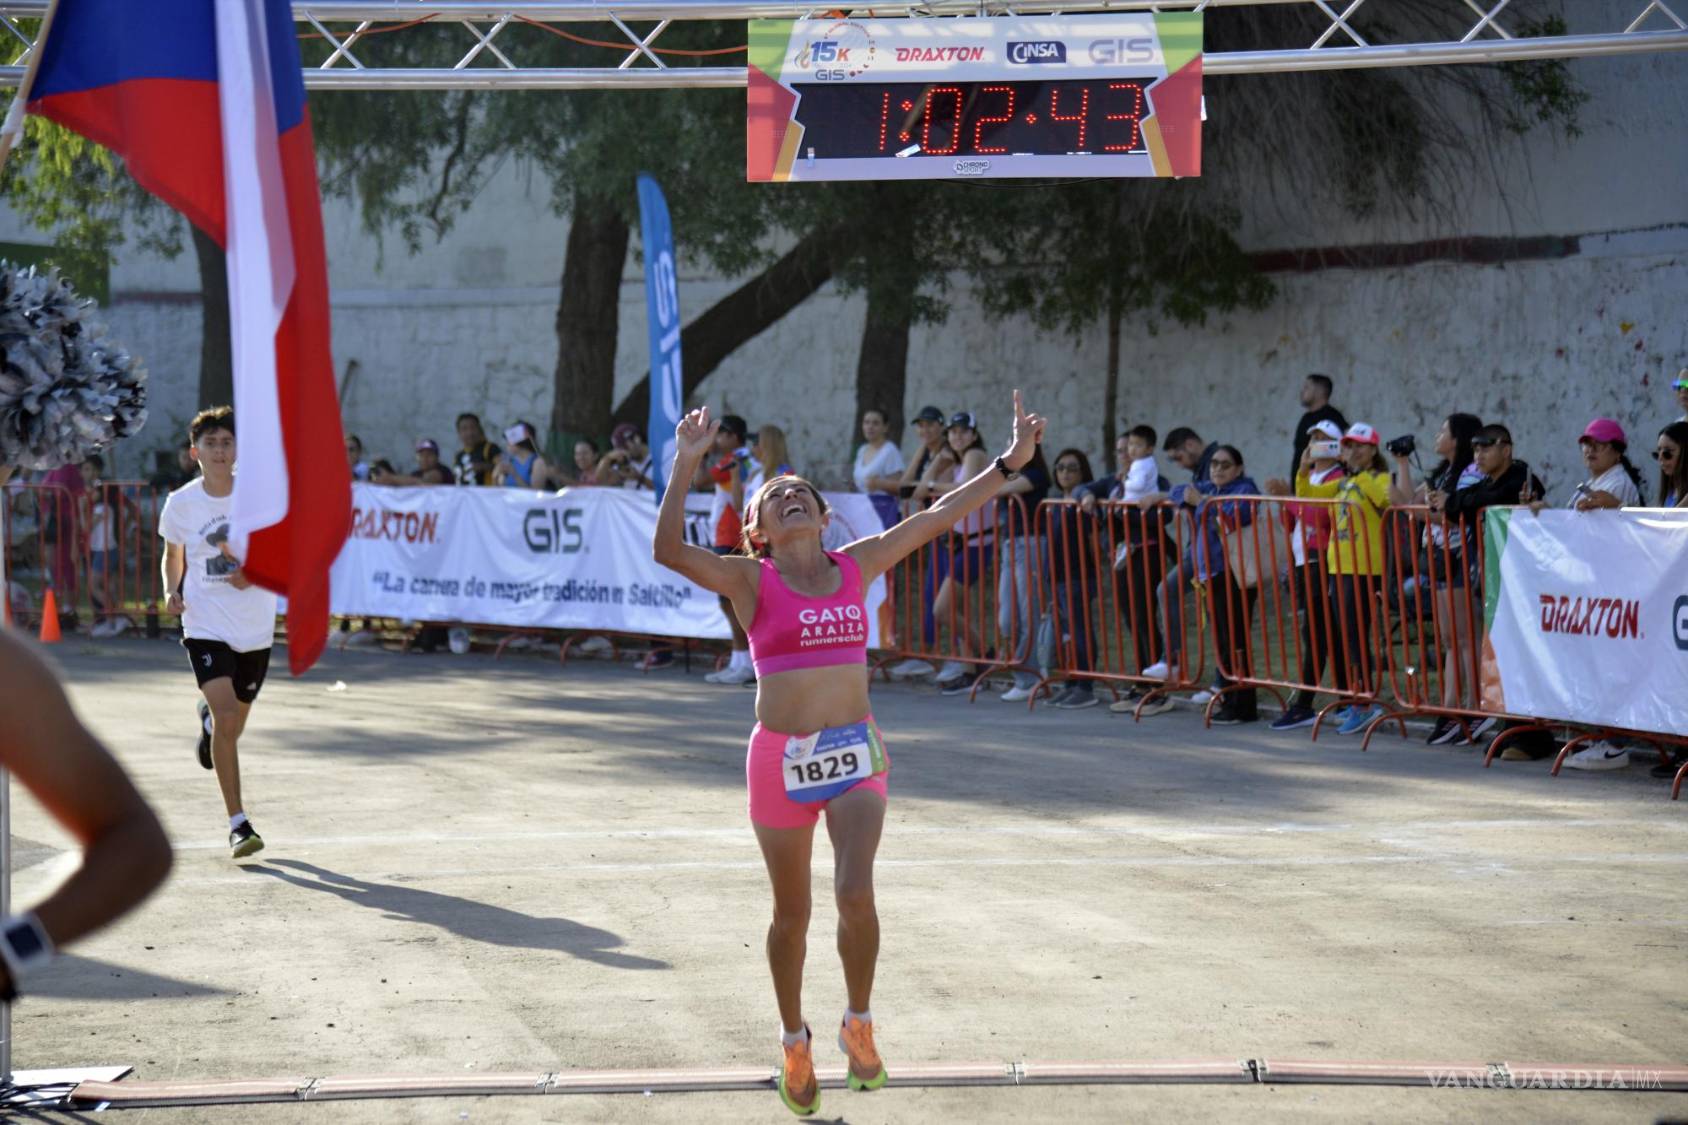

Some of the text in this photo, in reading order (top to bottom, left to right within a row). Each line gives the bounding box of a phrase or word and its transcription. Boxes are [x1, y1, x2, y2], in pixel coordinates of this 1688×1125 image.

[811, 41, 851, 62] 15K
[895, 46, 984, 62] DRAXTON
[1088, 38, 1154, 64] GIS
[815, 69, 845, 80] GIS
[351, 508, 438, 543] RAXTON
[523, 509, 584, 553] GIS
[464, 576, 486, 598] de
[1539, 594, 1640, 640] DRAXTON
[800, 633, 864, 647] runnersclub
[801, 622, 864, 637] ARAIZA
[791, 752, 859, 784] 1829
